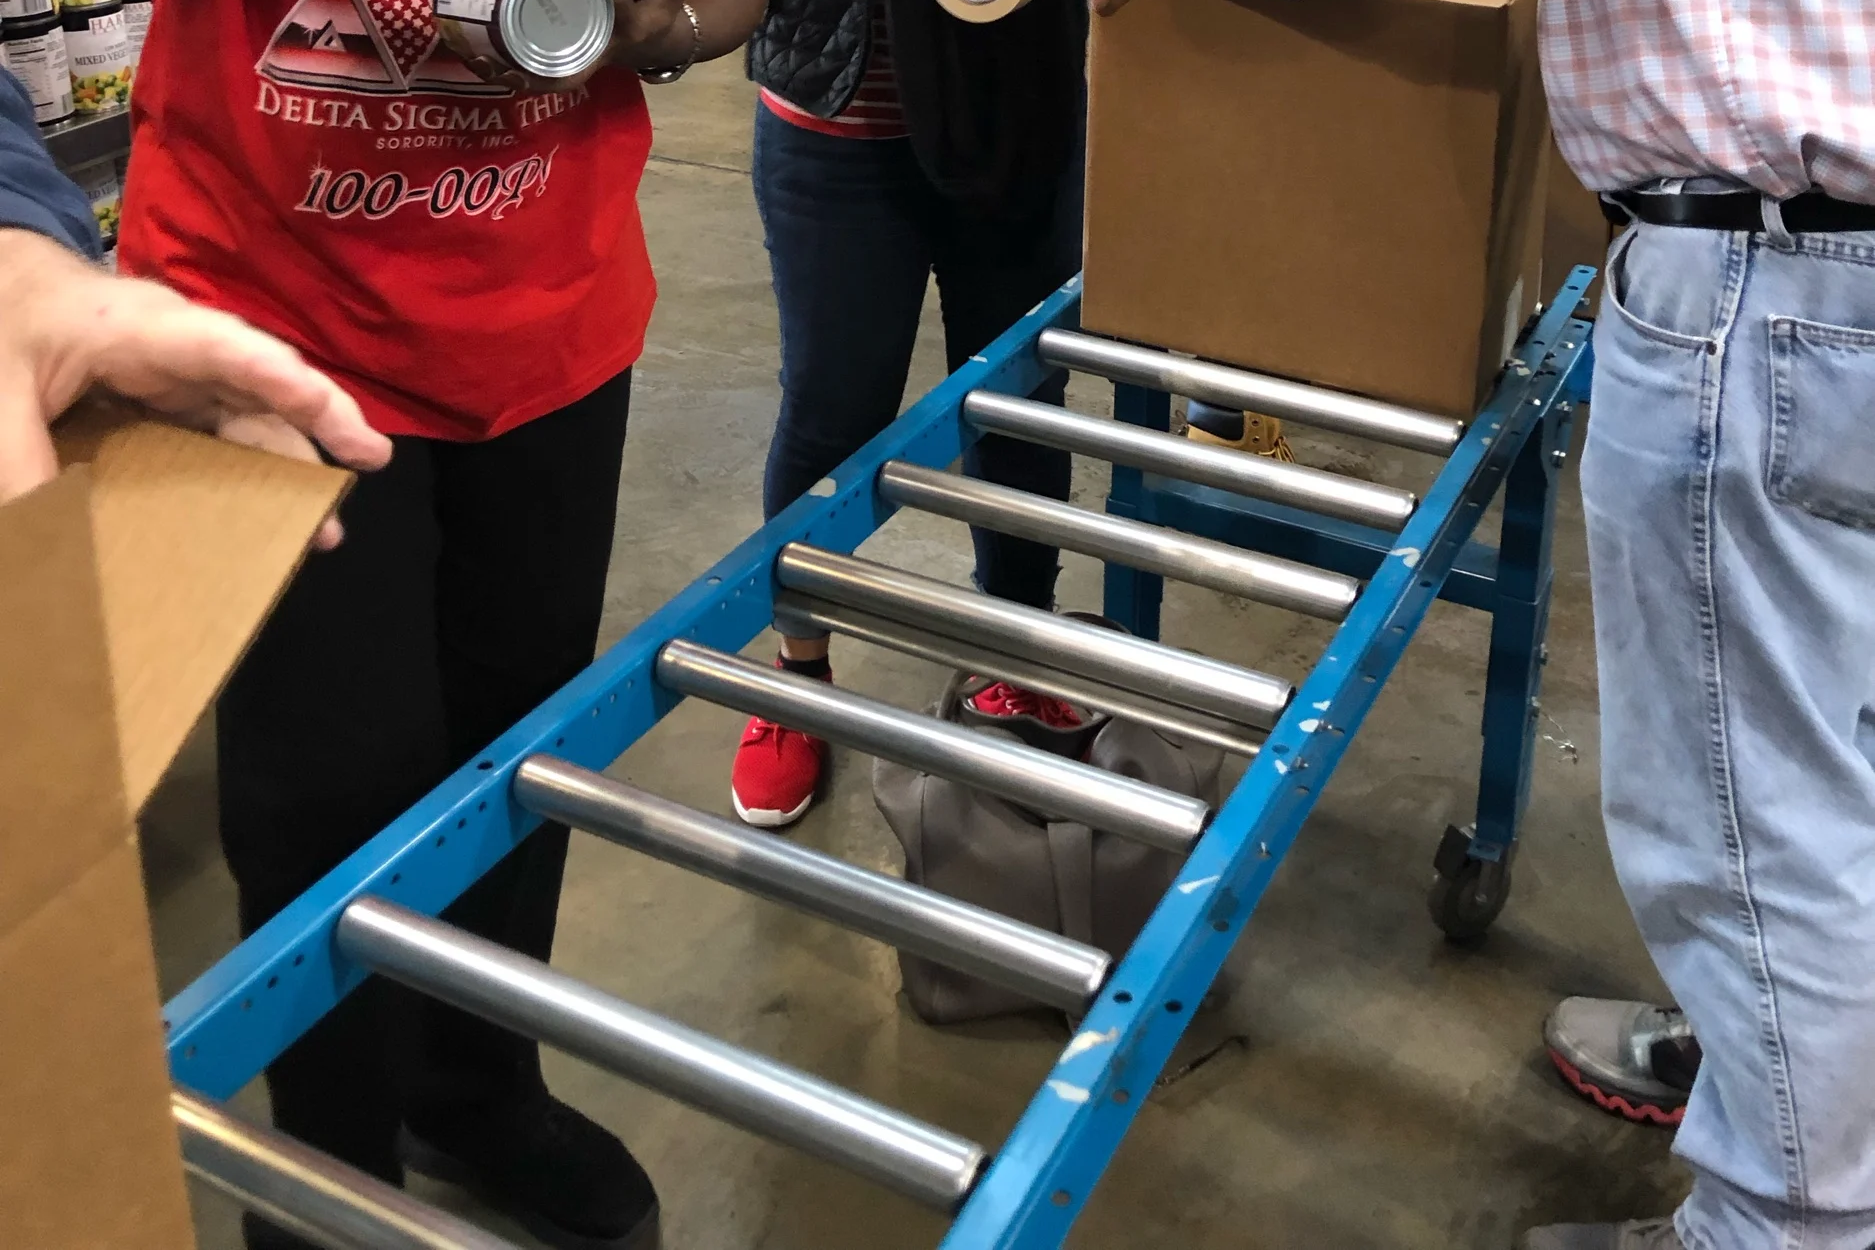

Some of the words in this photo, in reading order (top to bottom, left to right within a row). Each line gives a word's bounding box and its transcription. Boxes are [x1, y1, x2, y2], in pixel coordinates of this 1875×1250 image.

[75, 53, 107, 67] MIXED
[255, 80, 372, 130] DELTA
[384, 102, 507, 132] SIGMA
[482, 134, 520, 148] INC.
